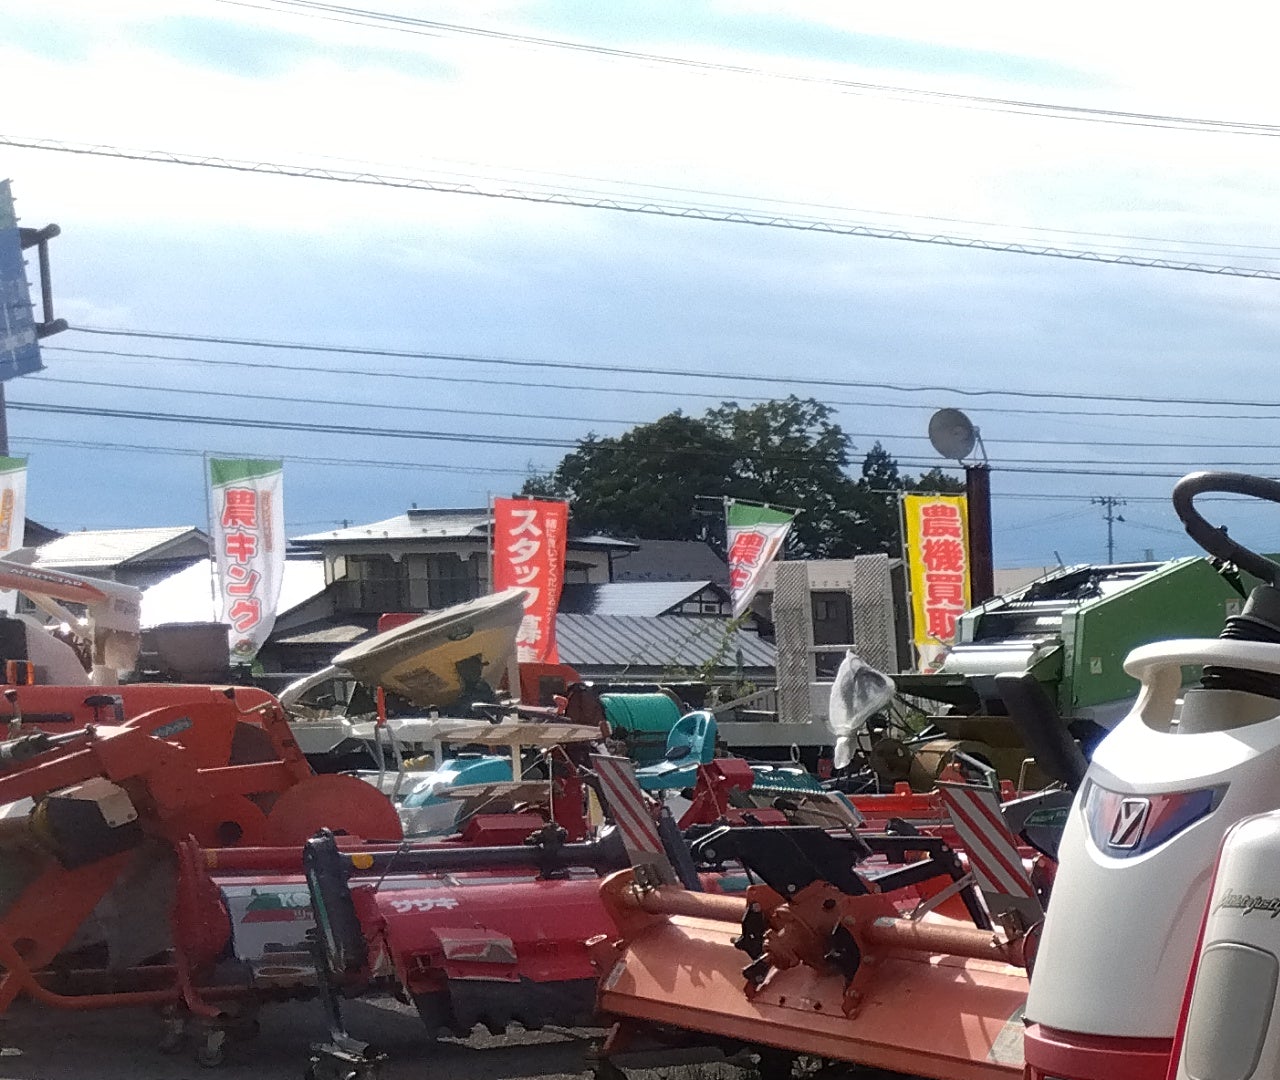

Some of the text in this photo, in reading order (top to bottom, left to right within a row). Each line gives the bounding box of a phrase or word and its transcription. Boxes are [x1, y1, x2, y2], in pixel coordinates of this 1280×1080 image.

[220, 487, 262, 633] 農キング
[921, 504, 965, 640] 農機買取
[390, 897, 459, 913] ササキ
